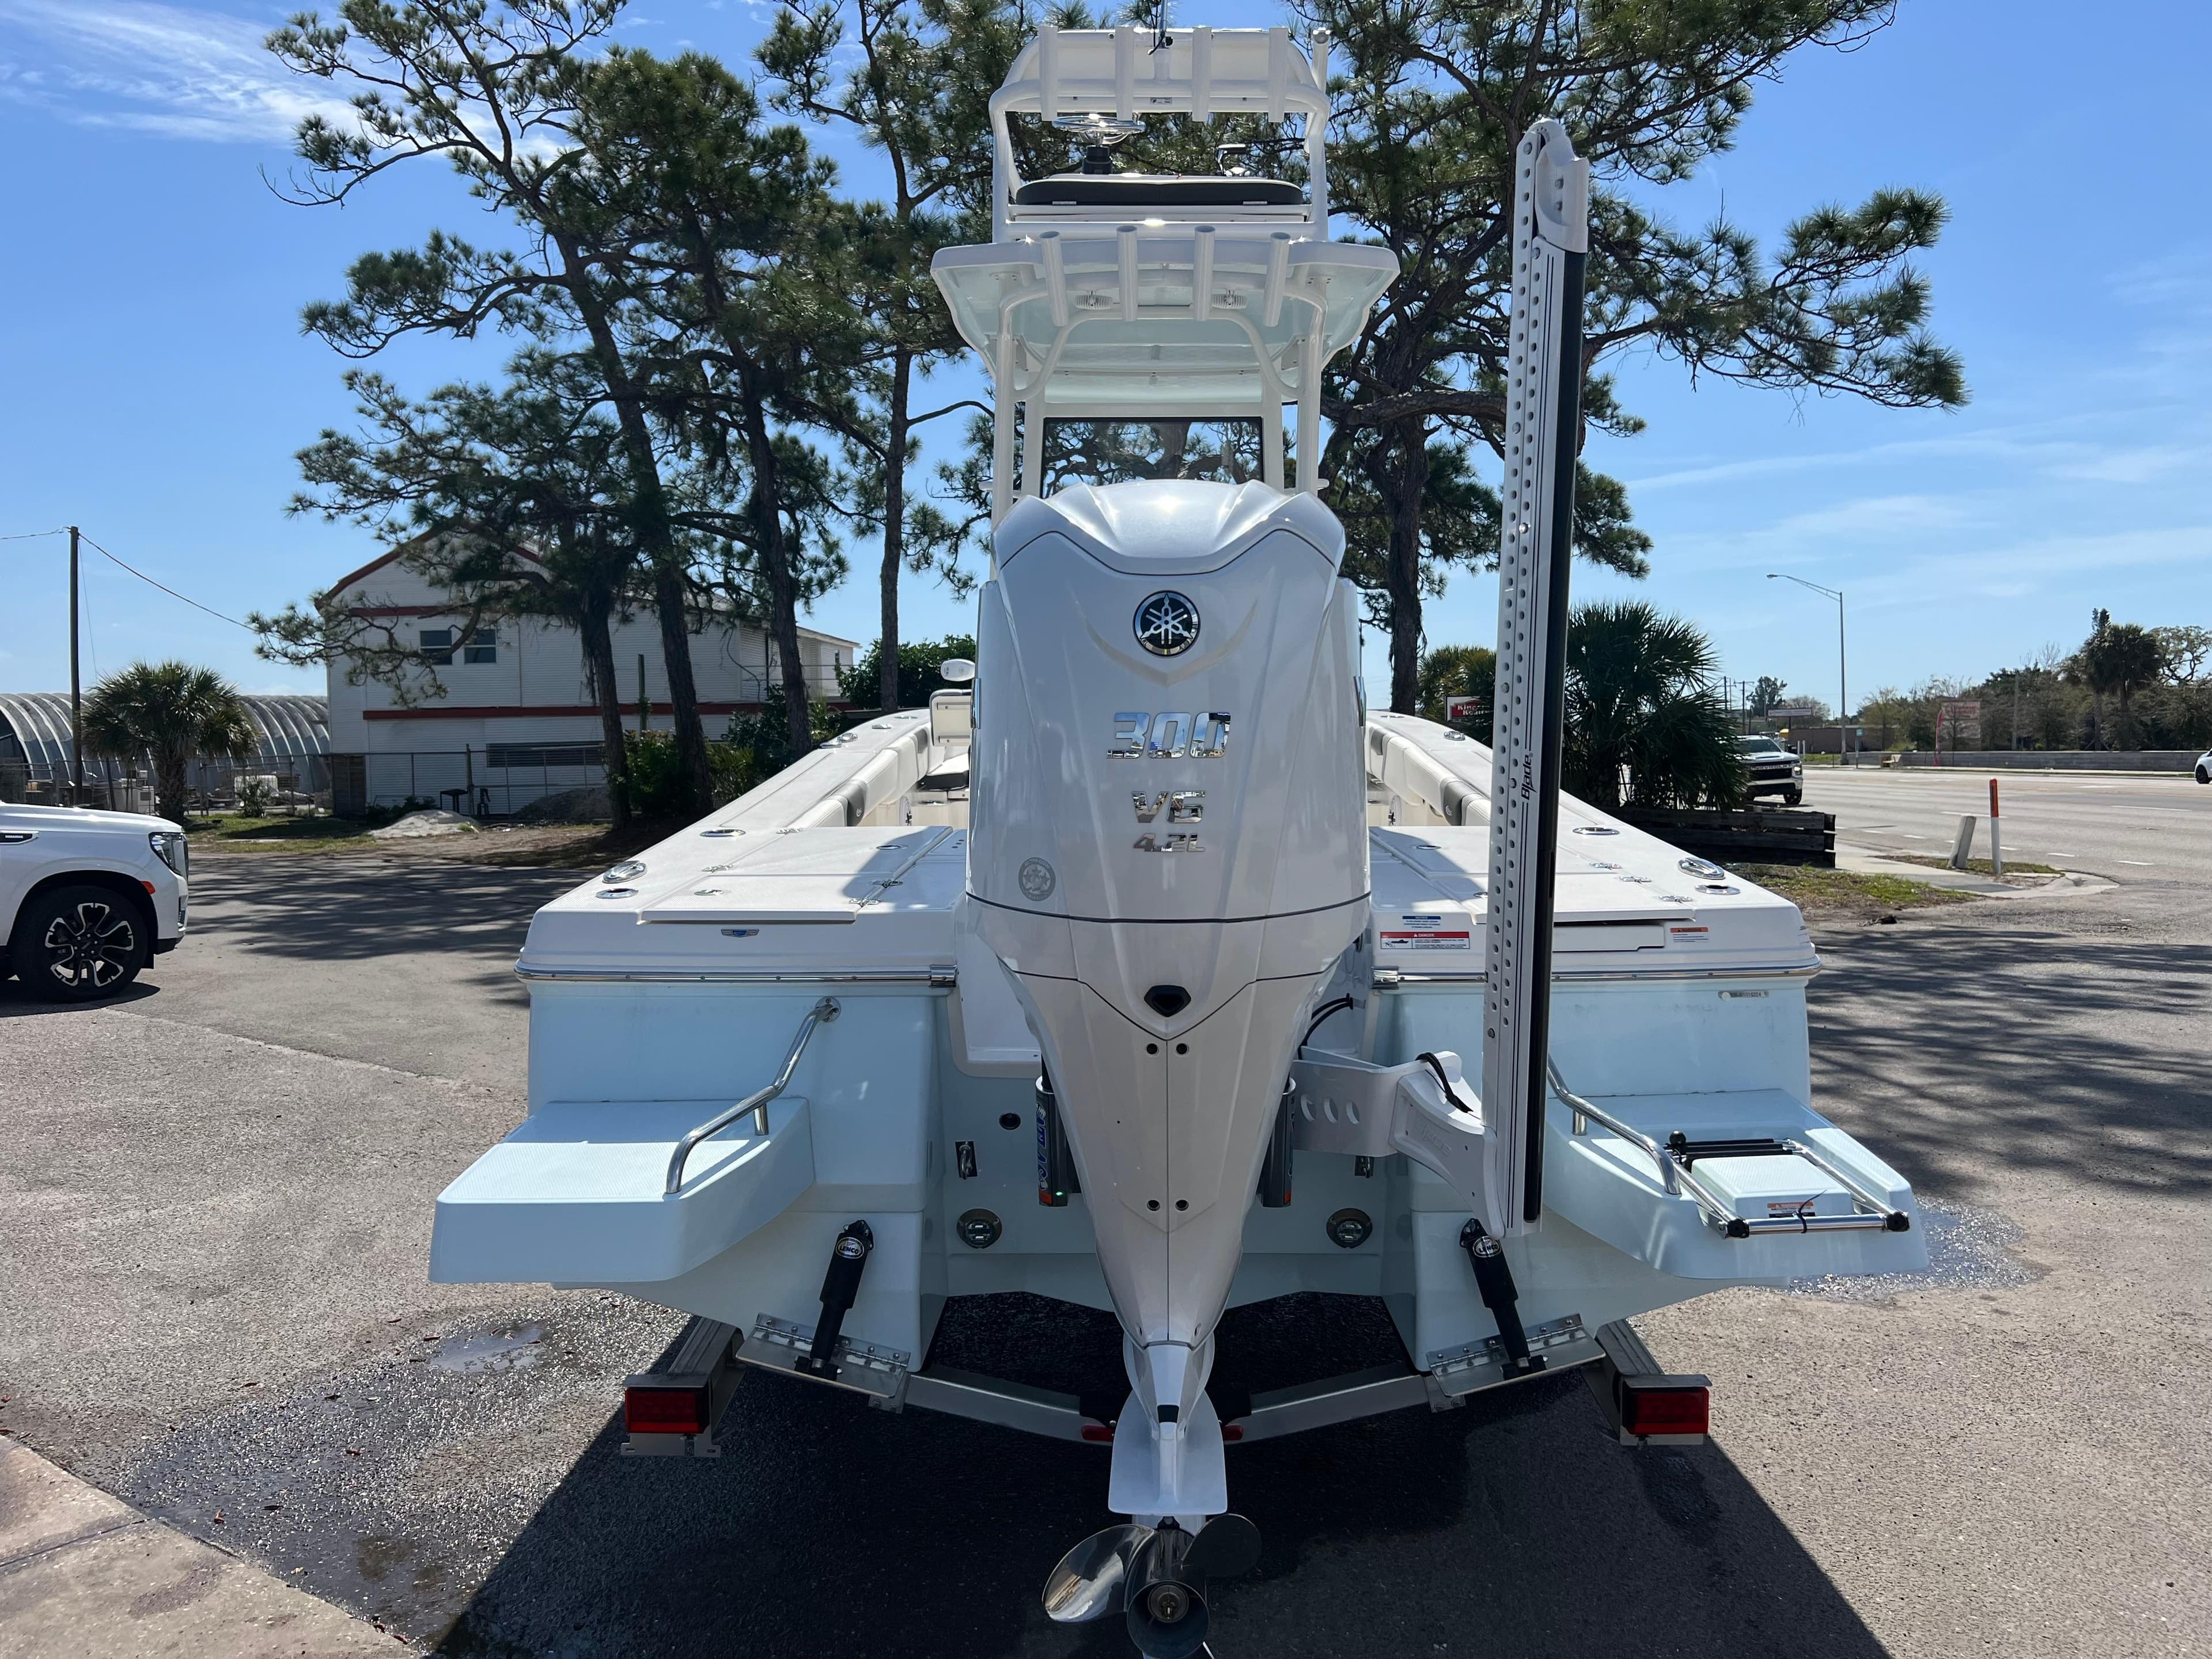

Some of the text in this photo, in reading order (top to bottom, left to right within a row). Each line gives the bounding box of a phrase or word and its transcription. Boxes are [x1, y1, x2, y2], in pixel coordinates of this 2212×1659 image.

[1105, 712, 1231, 759] 300
[1131, 790, 1206, 824] V6
[1133, 833, 1206, 853] 4.2L
[839, 1245, 859, 1255] LENCO
[1478, 1244, 1498, 1253] LENCO
